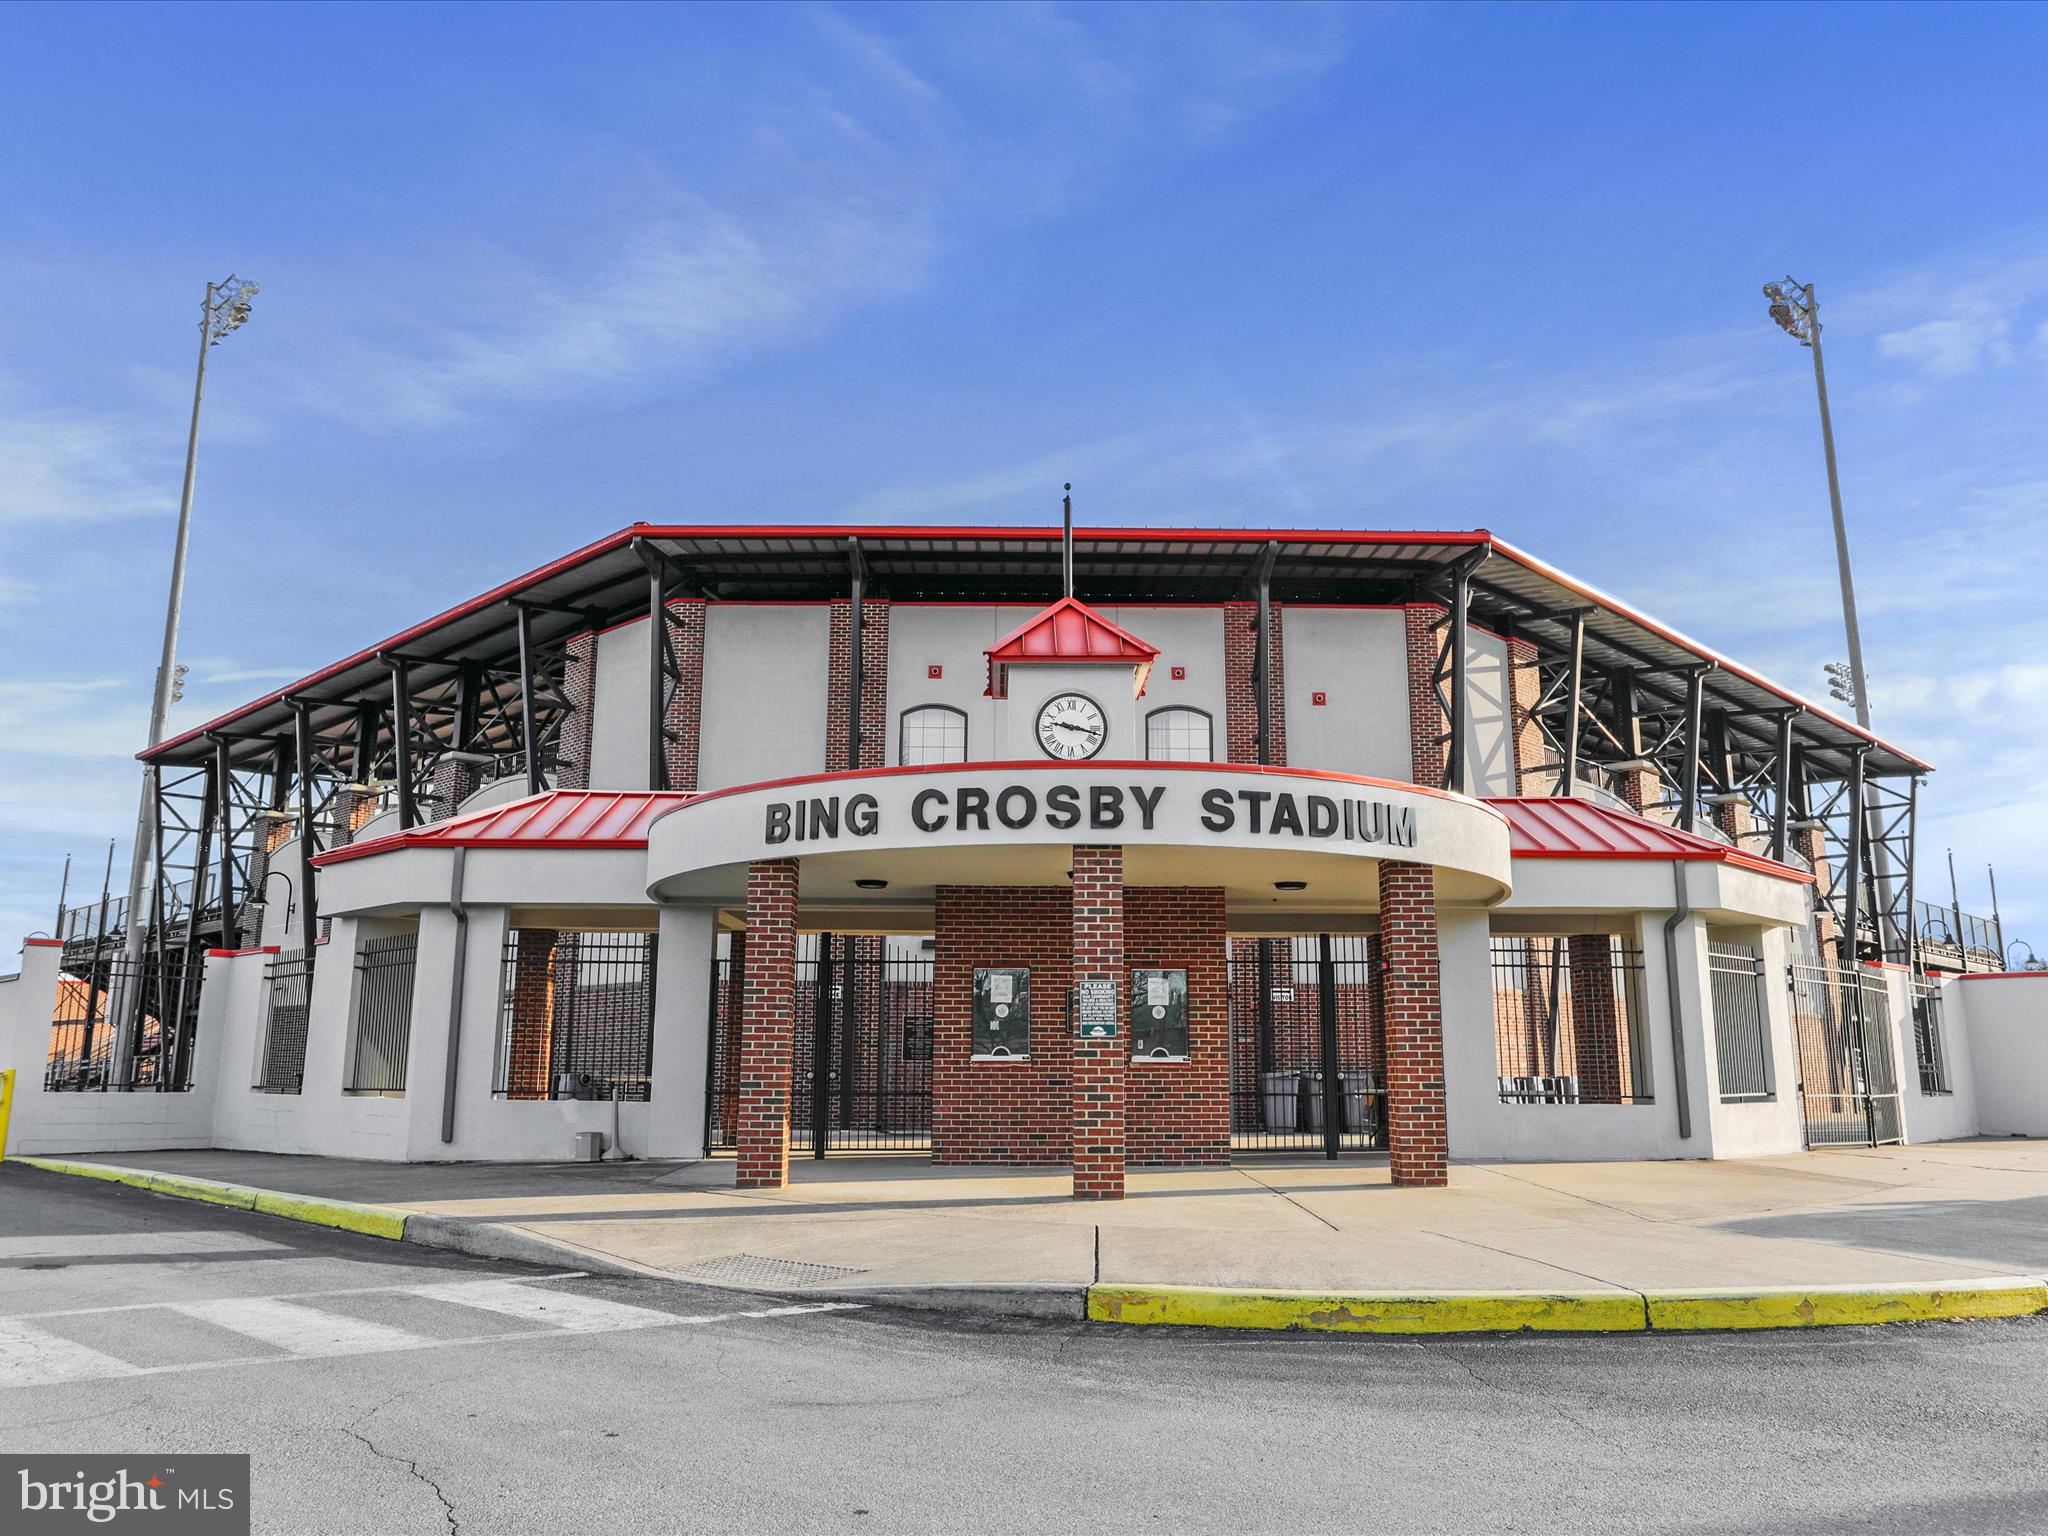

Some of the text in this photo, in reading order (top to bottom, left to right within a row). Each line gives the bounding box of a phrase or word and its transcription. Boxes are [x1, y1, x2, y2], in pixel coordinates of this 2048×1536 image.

[765, 785, 1418, 847] BING CROSBY STADIUM
